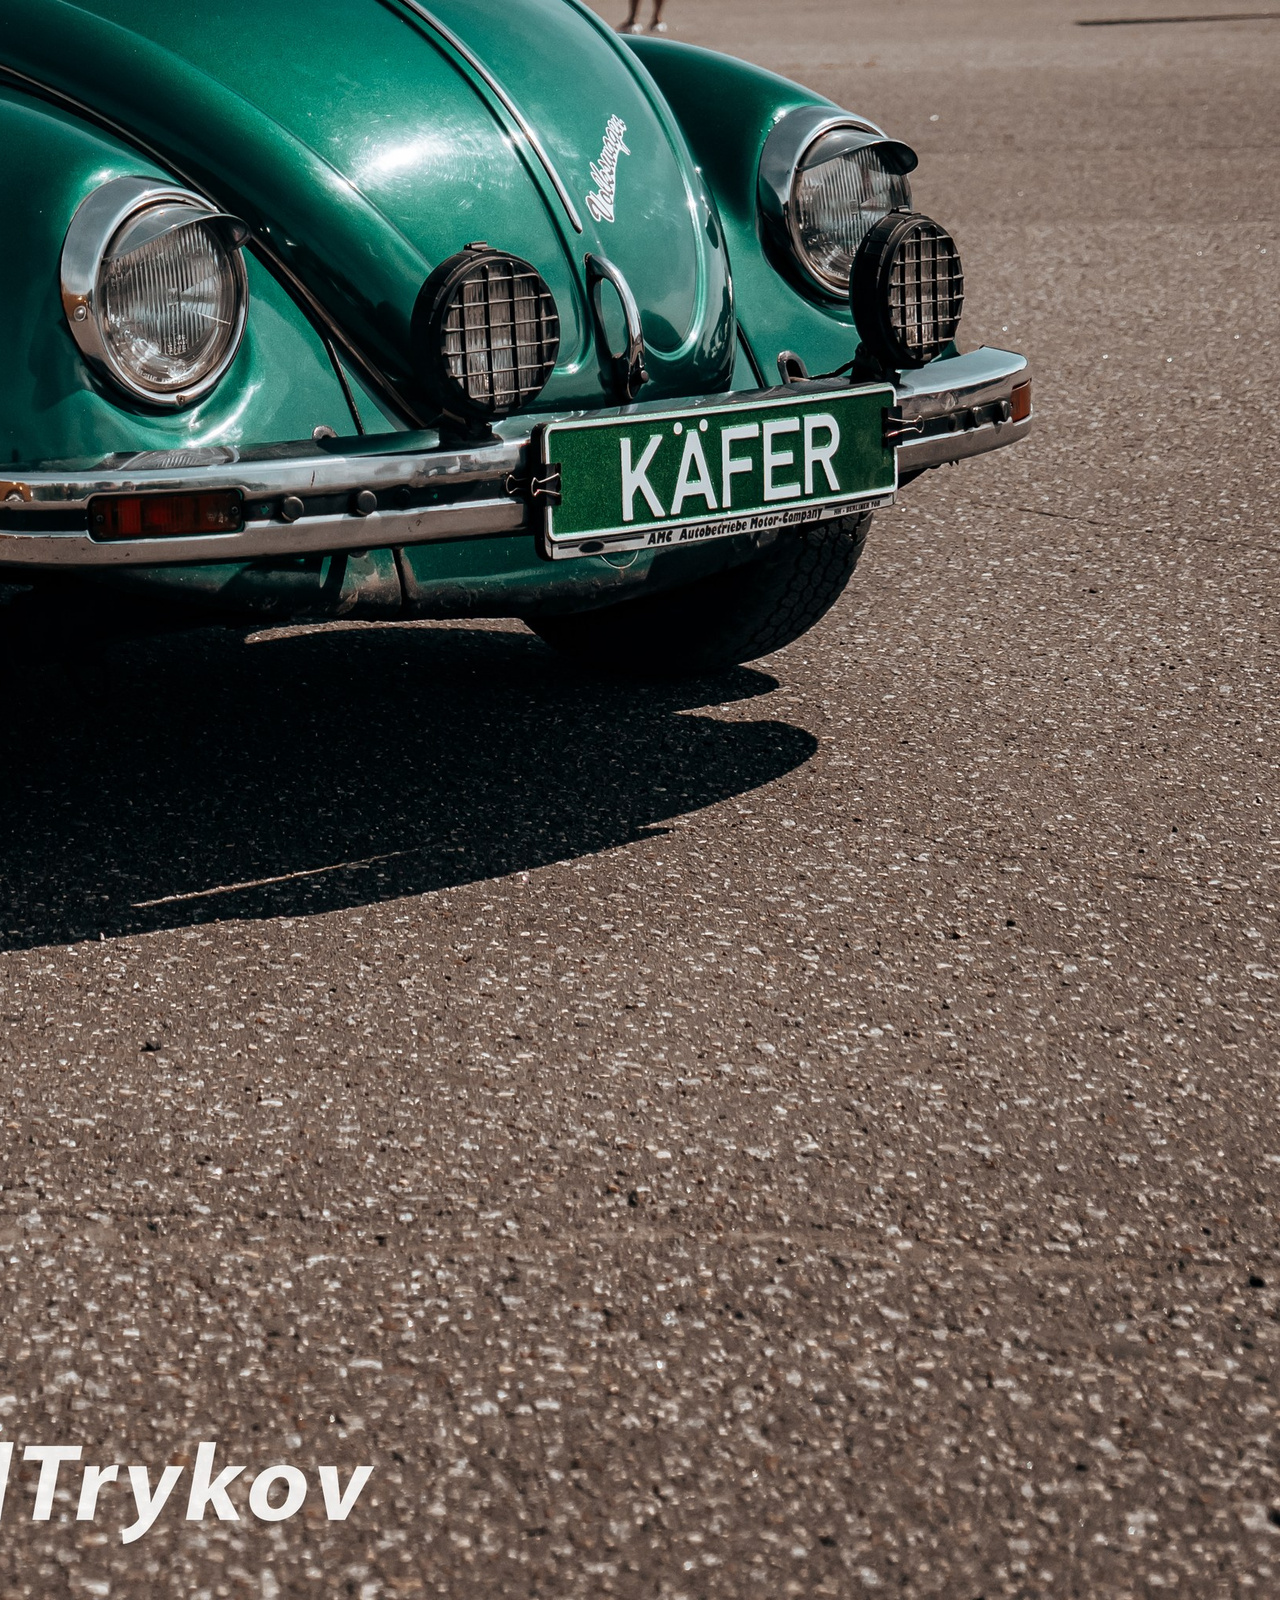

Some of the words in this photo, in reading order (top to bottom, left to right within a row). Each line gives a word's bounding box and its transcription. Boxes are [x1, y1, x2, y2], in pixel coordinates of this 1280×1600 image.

[620, 412, 841, 522] KÄFER
[647, 530, 674, 546] AMC
[679, 519, 748, 541] Autobetriebe
[750, 507, 824, 530] Motor-Company
